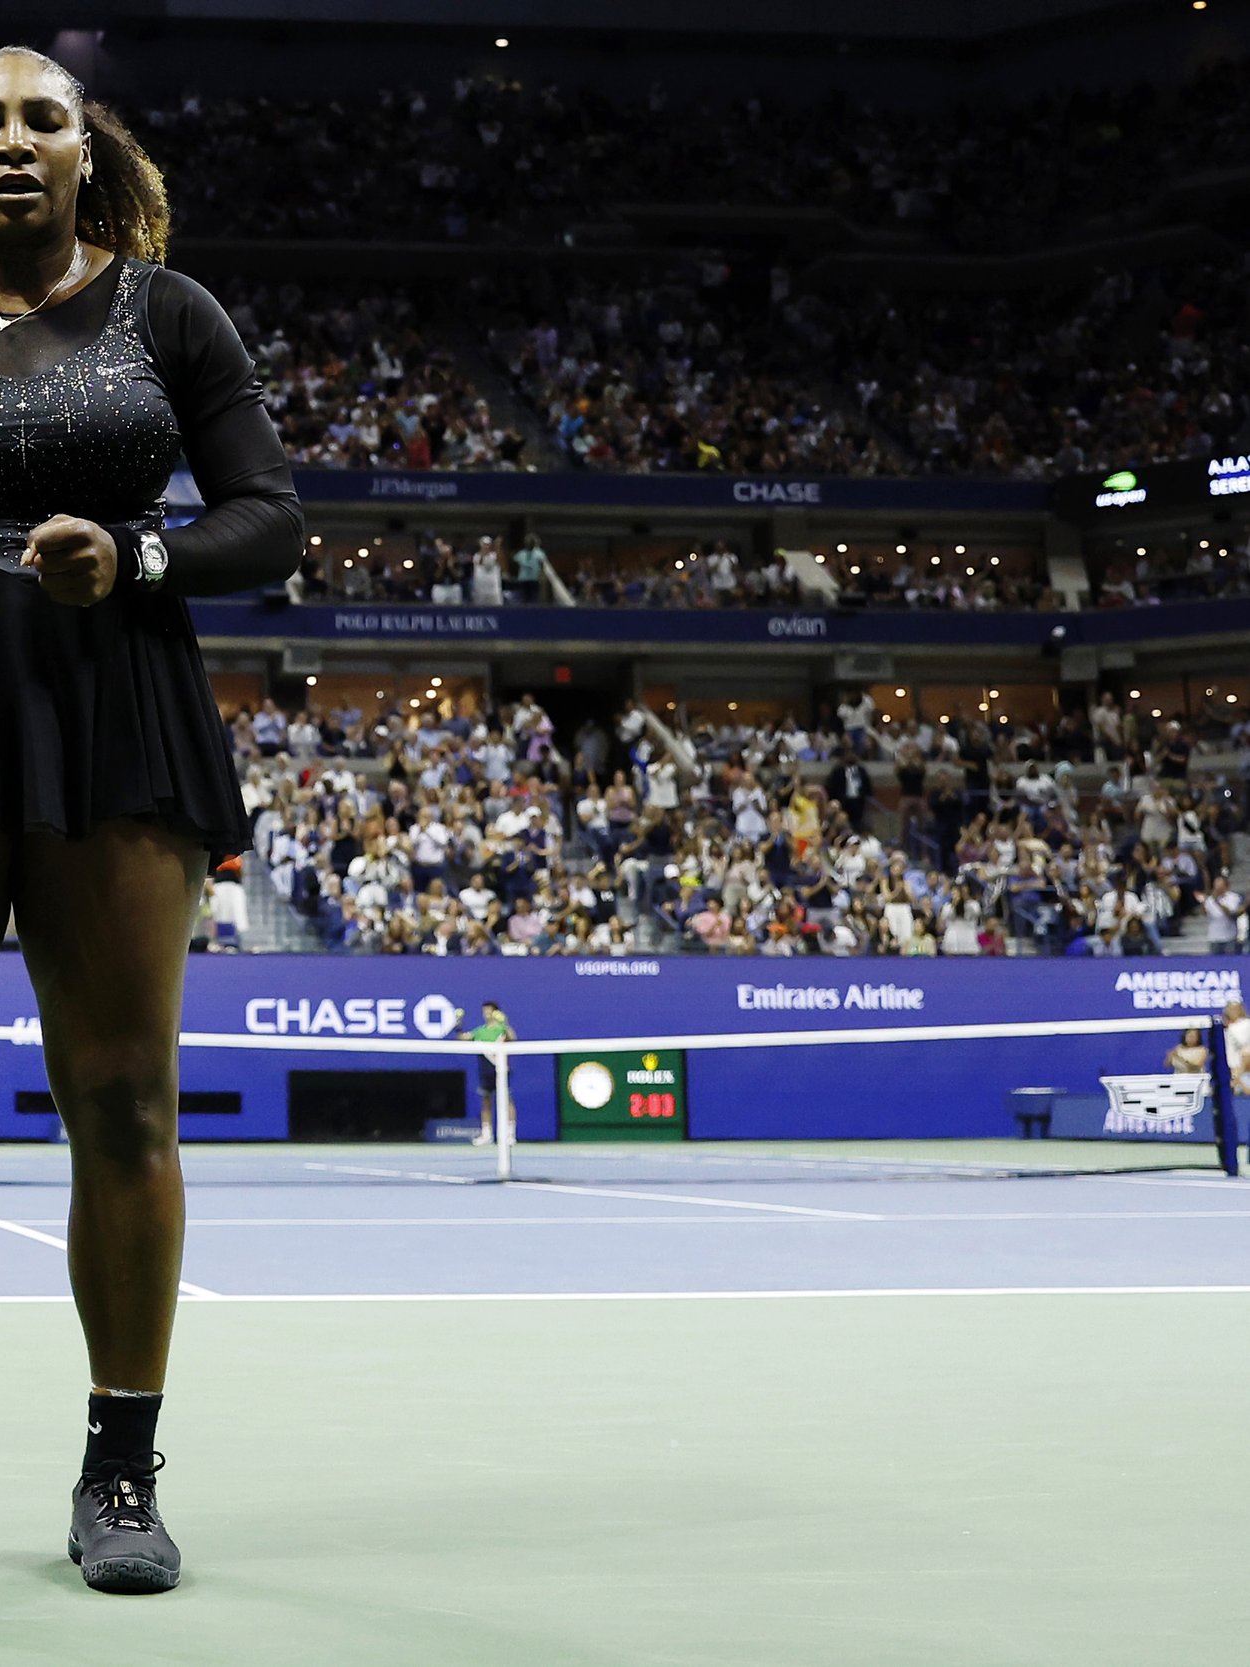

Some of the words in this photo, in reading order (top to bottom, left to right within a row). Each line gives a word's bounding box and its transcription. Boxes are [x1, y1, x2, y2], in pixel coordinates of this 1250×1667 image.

[733, 481, 820, 502] CHASE
[335, 613, 379, 630] POLO
[381, 613, 434, 631] RALPH
[436, 615, 498, 631] LAUREN
[1115, 970, 1240, 991] AMERICAN
[736, 983, 841, 1010] Emirates
[843, 984, 925, 1010] Airline
[245, 998, 407, 1034] CHASE
